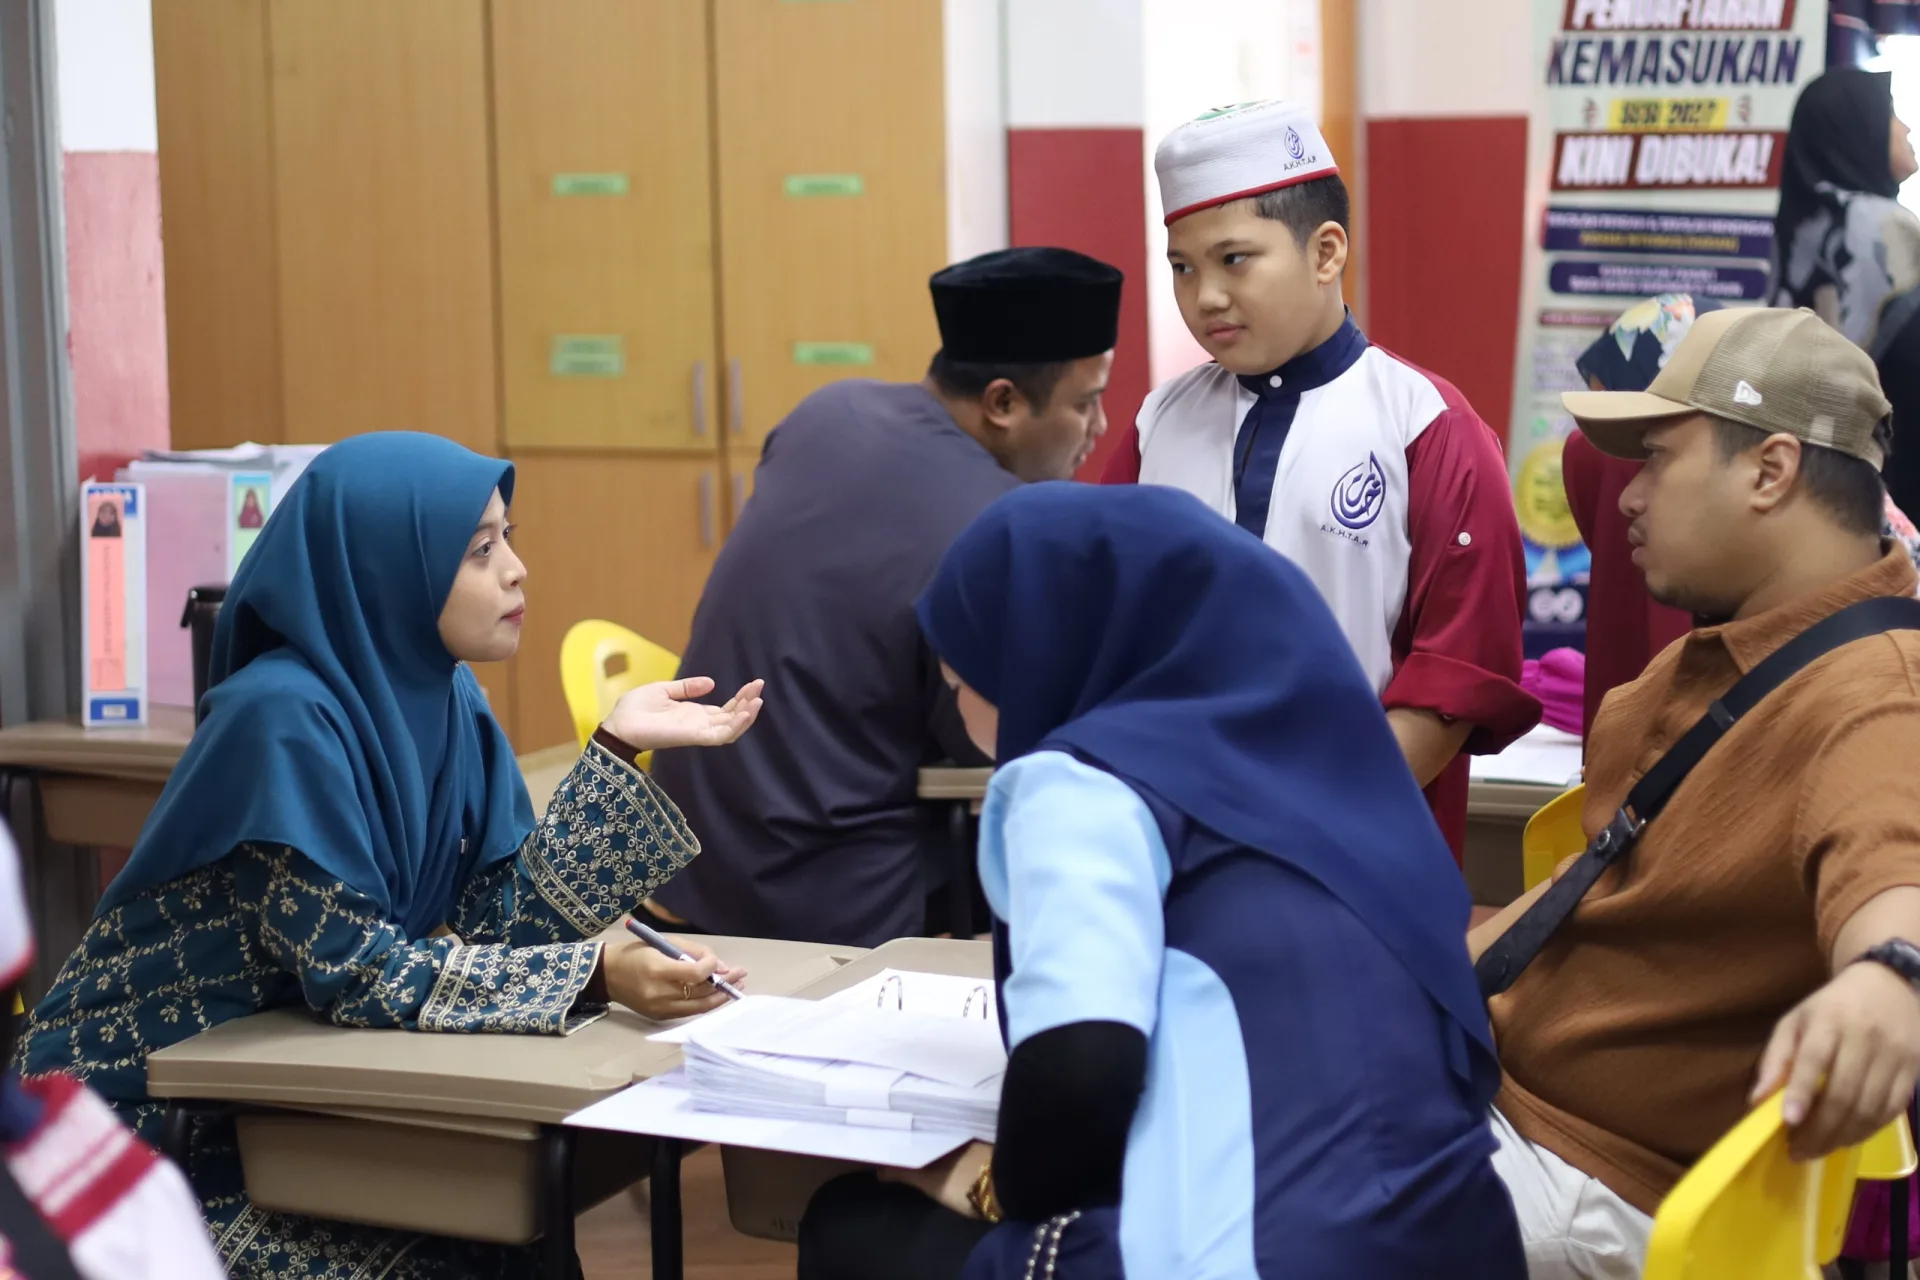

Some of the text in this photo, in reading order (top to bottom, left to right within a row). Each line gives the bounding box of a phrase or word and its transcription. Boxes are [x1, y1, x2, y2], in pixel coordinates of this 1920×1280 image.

[1548, 37, 1802, 85] KEMASUKAN
[1557, 133, 1774, 184] KINI DIBUKA!
[1320, 524, 1369, 547] A.K.H.T.A.R
